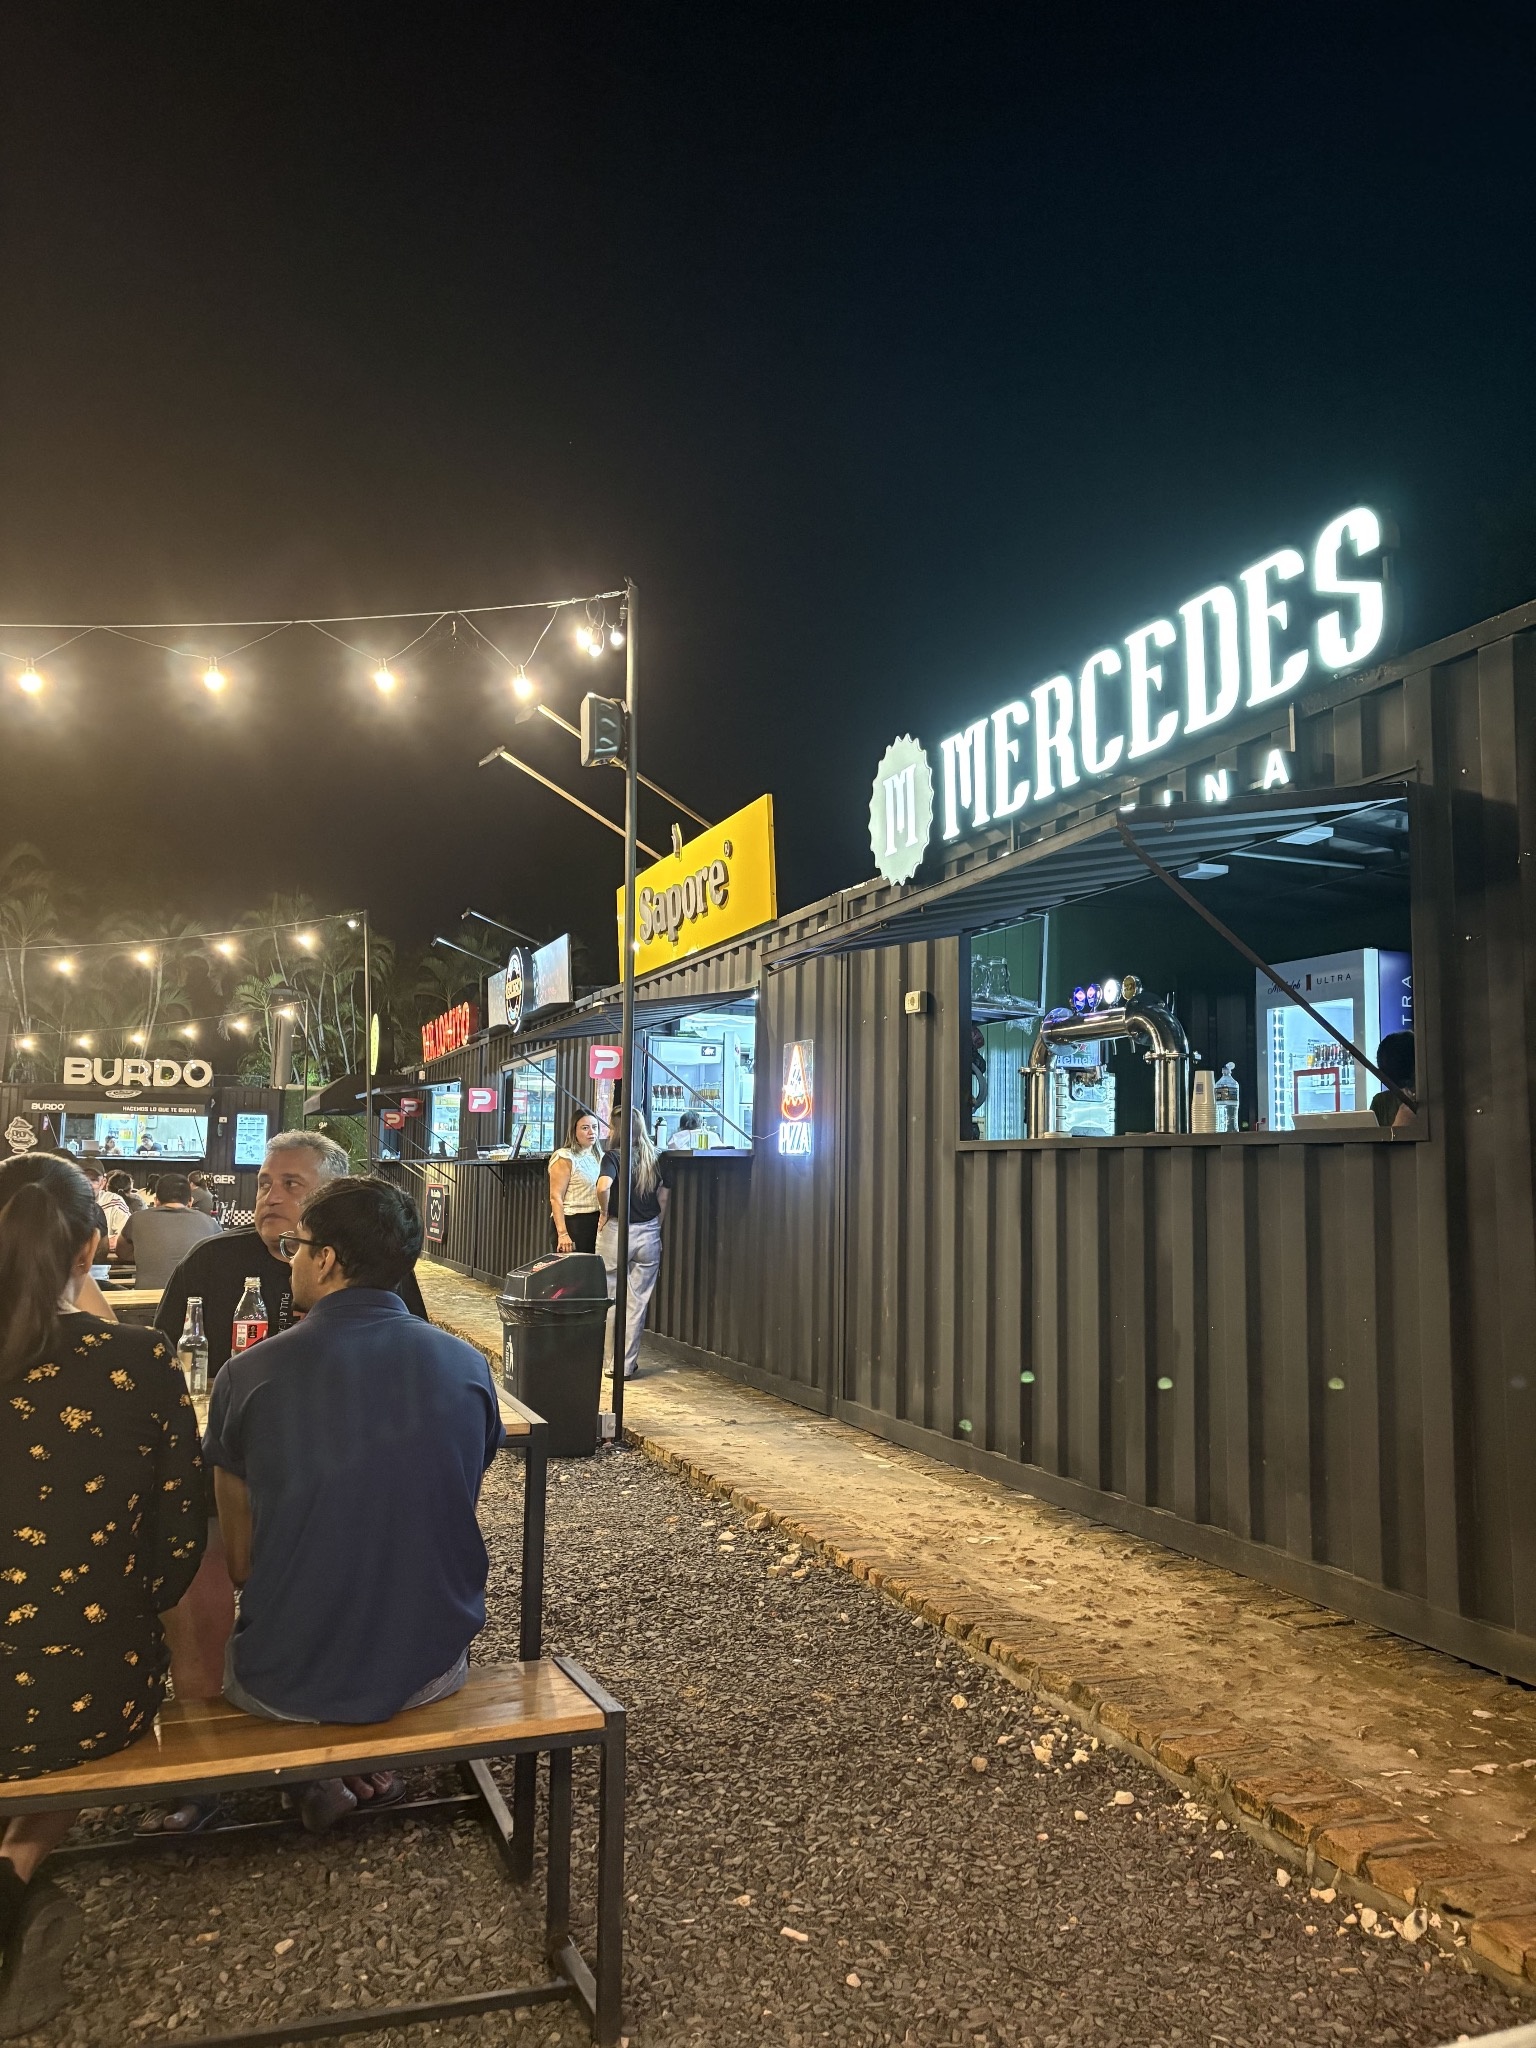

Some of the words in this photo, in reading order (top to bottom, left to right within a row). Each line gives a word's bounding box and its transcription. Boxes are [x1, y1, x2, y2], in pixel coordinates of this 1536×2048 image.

[941, 506, 1385, 841] MERCEDES
[882, 763, 918, 858] M
[639, 859, 729, 944] Sapore
[1316, 973, 1352, 985] ULTRA
[1401, 975, 1413, 1026] TRA
[63, 1056, 213, 1088] BURDO
[31, 1102, 64, 1111] BURDO
[779, 1121, 811, 1154] PIZZA
